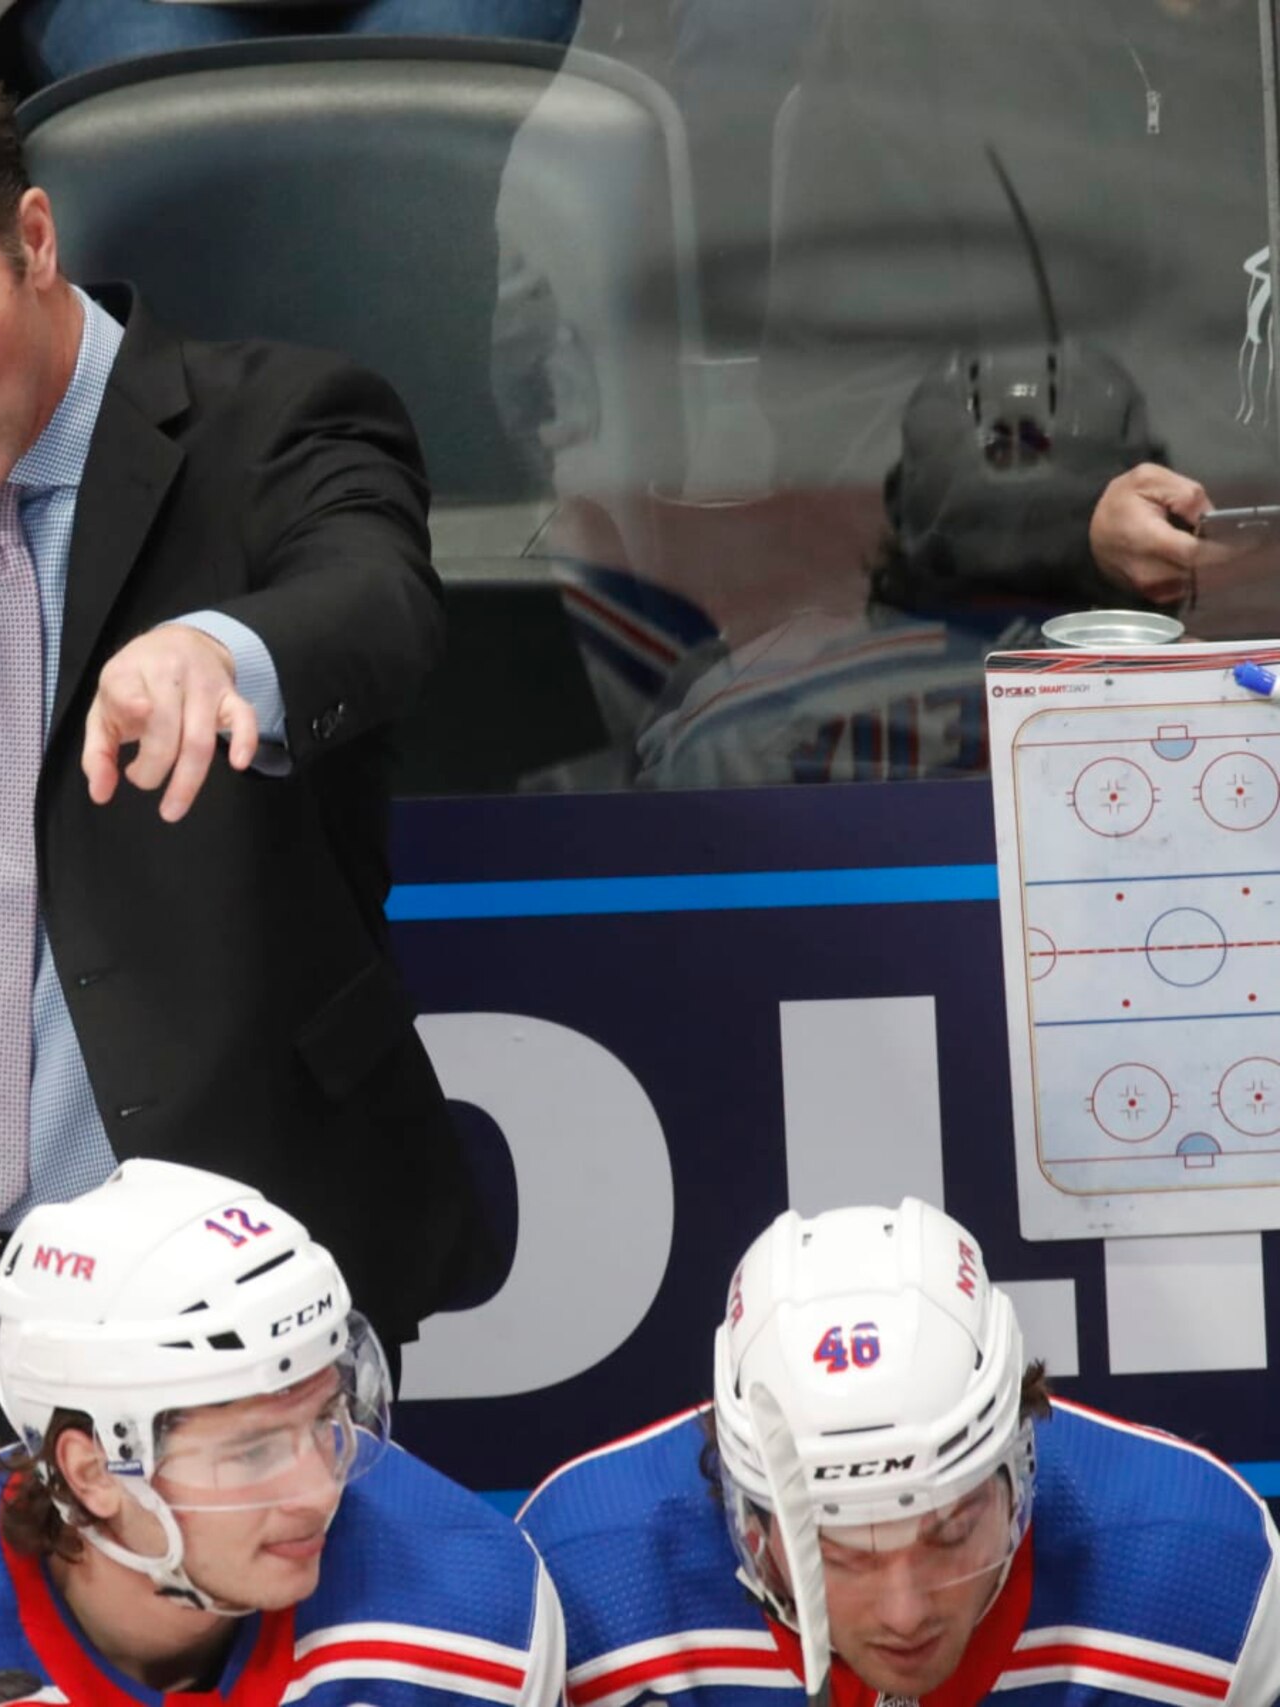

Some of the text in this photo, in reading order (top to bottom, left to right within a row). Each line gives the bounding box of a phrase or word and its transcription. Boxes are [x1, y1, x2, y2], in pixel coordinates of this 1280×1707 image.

[205, 1208, 272, 1249] 12
[33, 1244, 96, 1282] NYR
[956, 1239, 978, 1301] NYR
[270, 1293, 333, 1338] CCM
[813, 1454, 916, 1481] CCM
